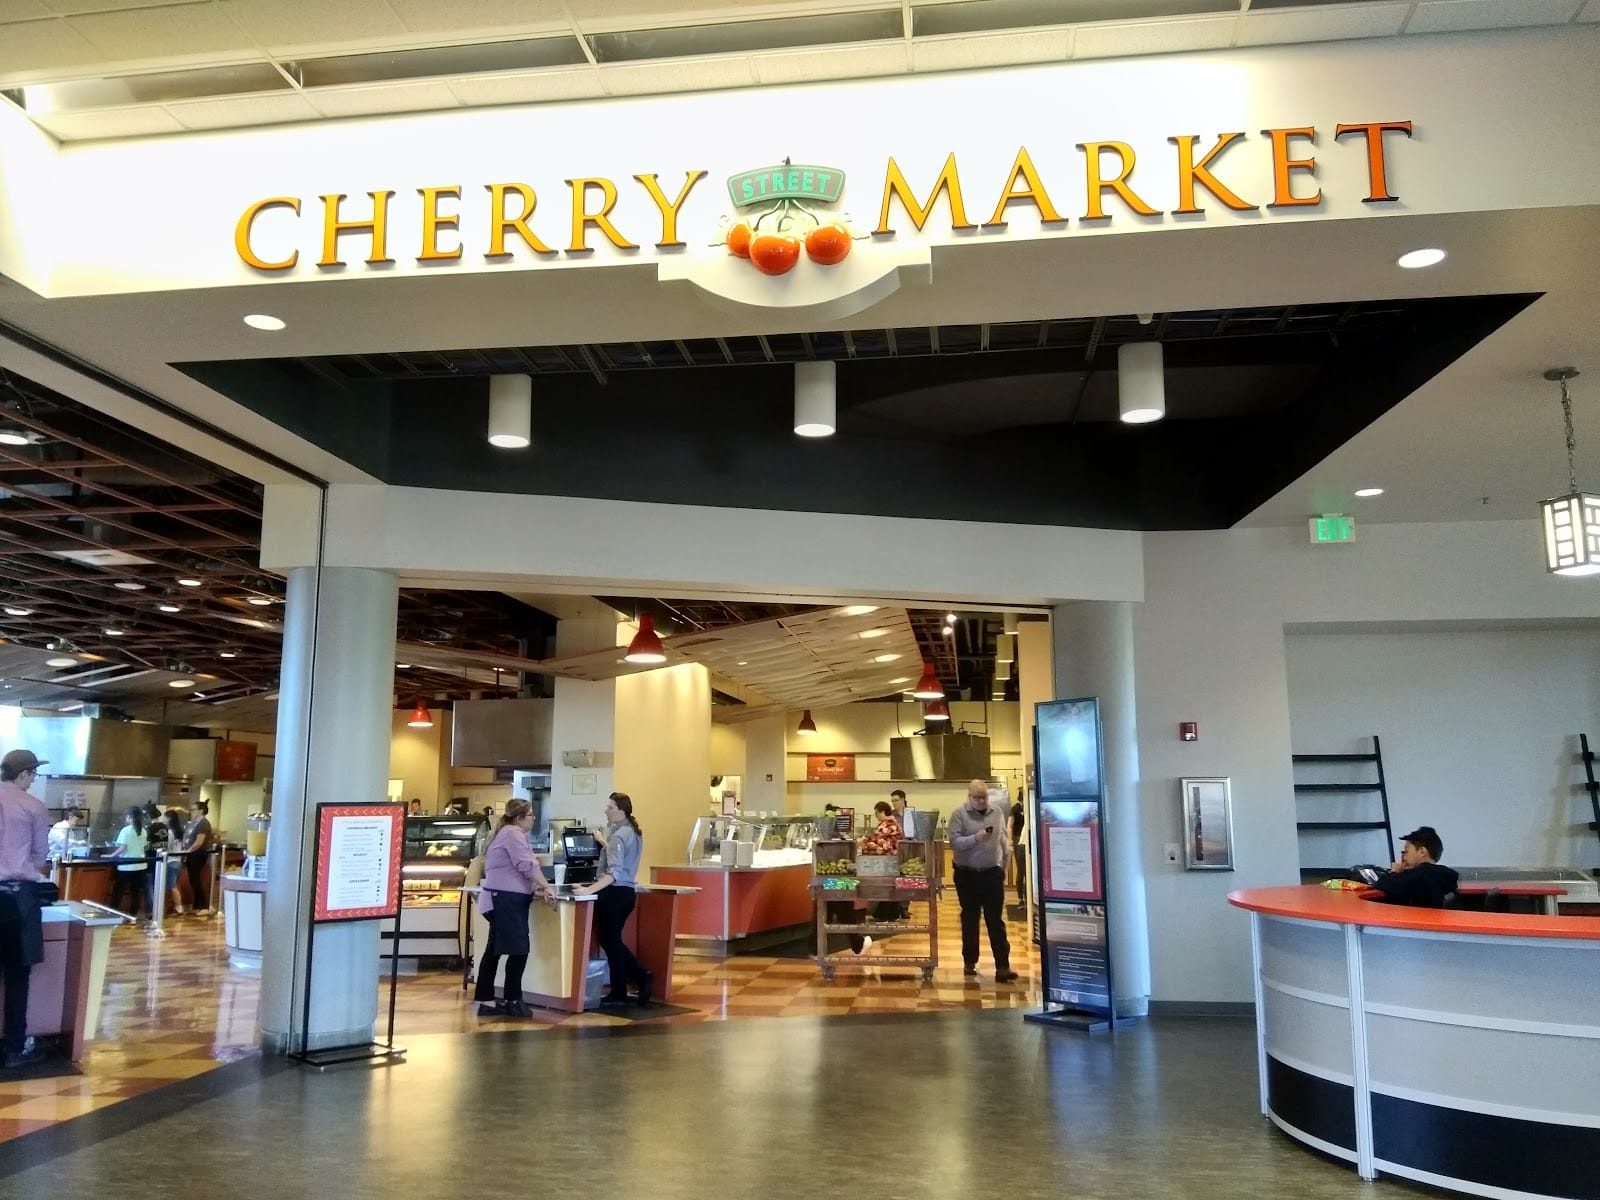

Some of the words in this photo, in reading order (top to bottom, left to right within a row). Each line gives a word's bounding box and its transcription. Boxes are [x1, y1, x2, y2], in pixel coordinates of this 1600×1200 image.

[234, 170, 708, 272] CHERRY
[742, 171, 832, 199] STREET
[871, 121, 1413, 236] MARKET
